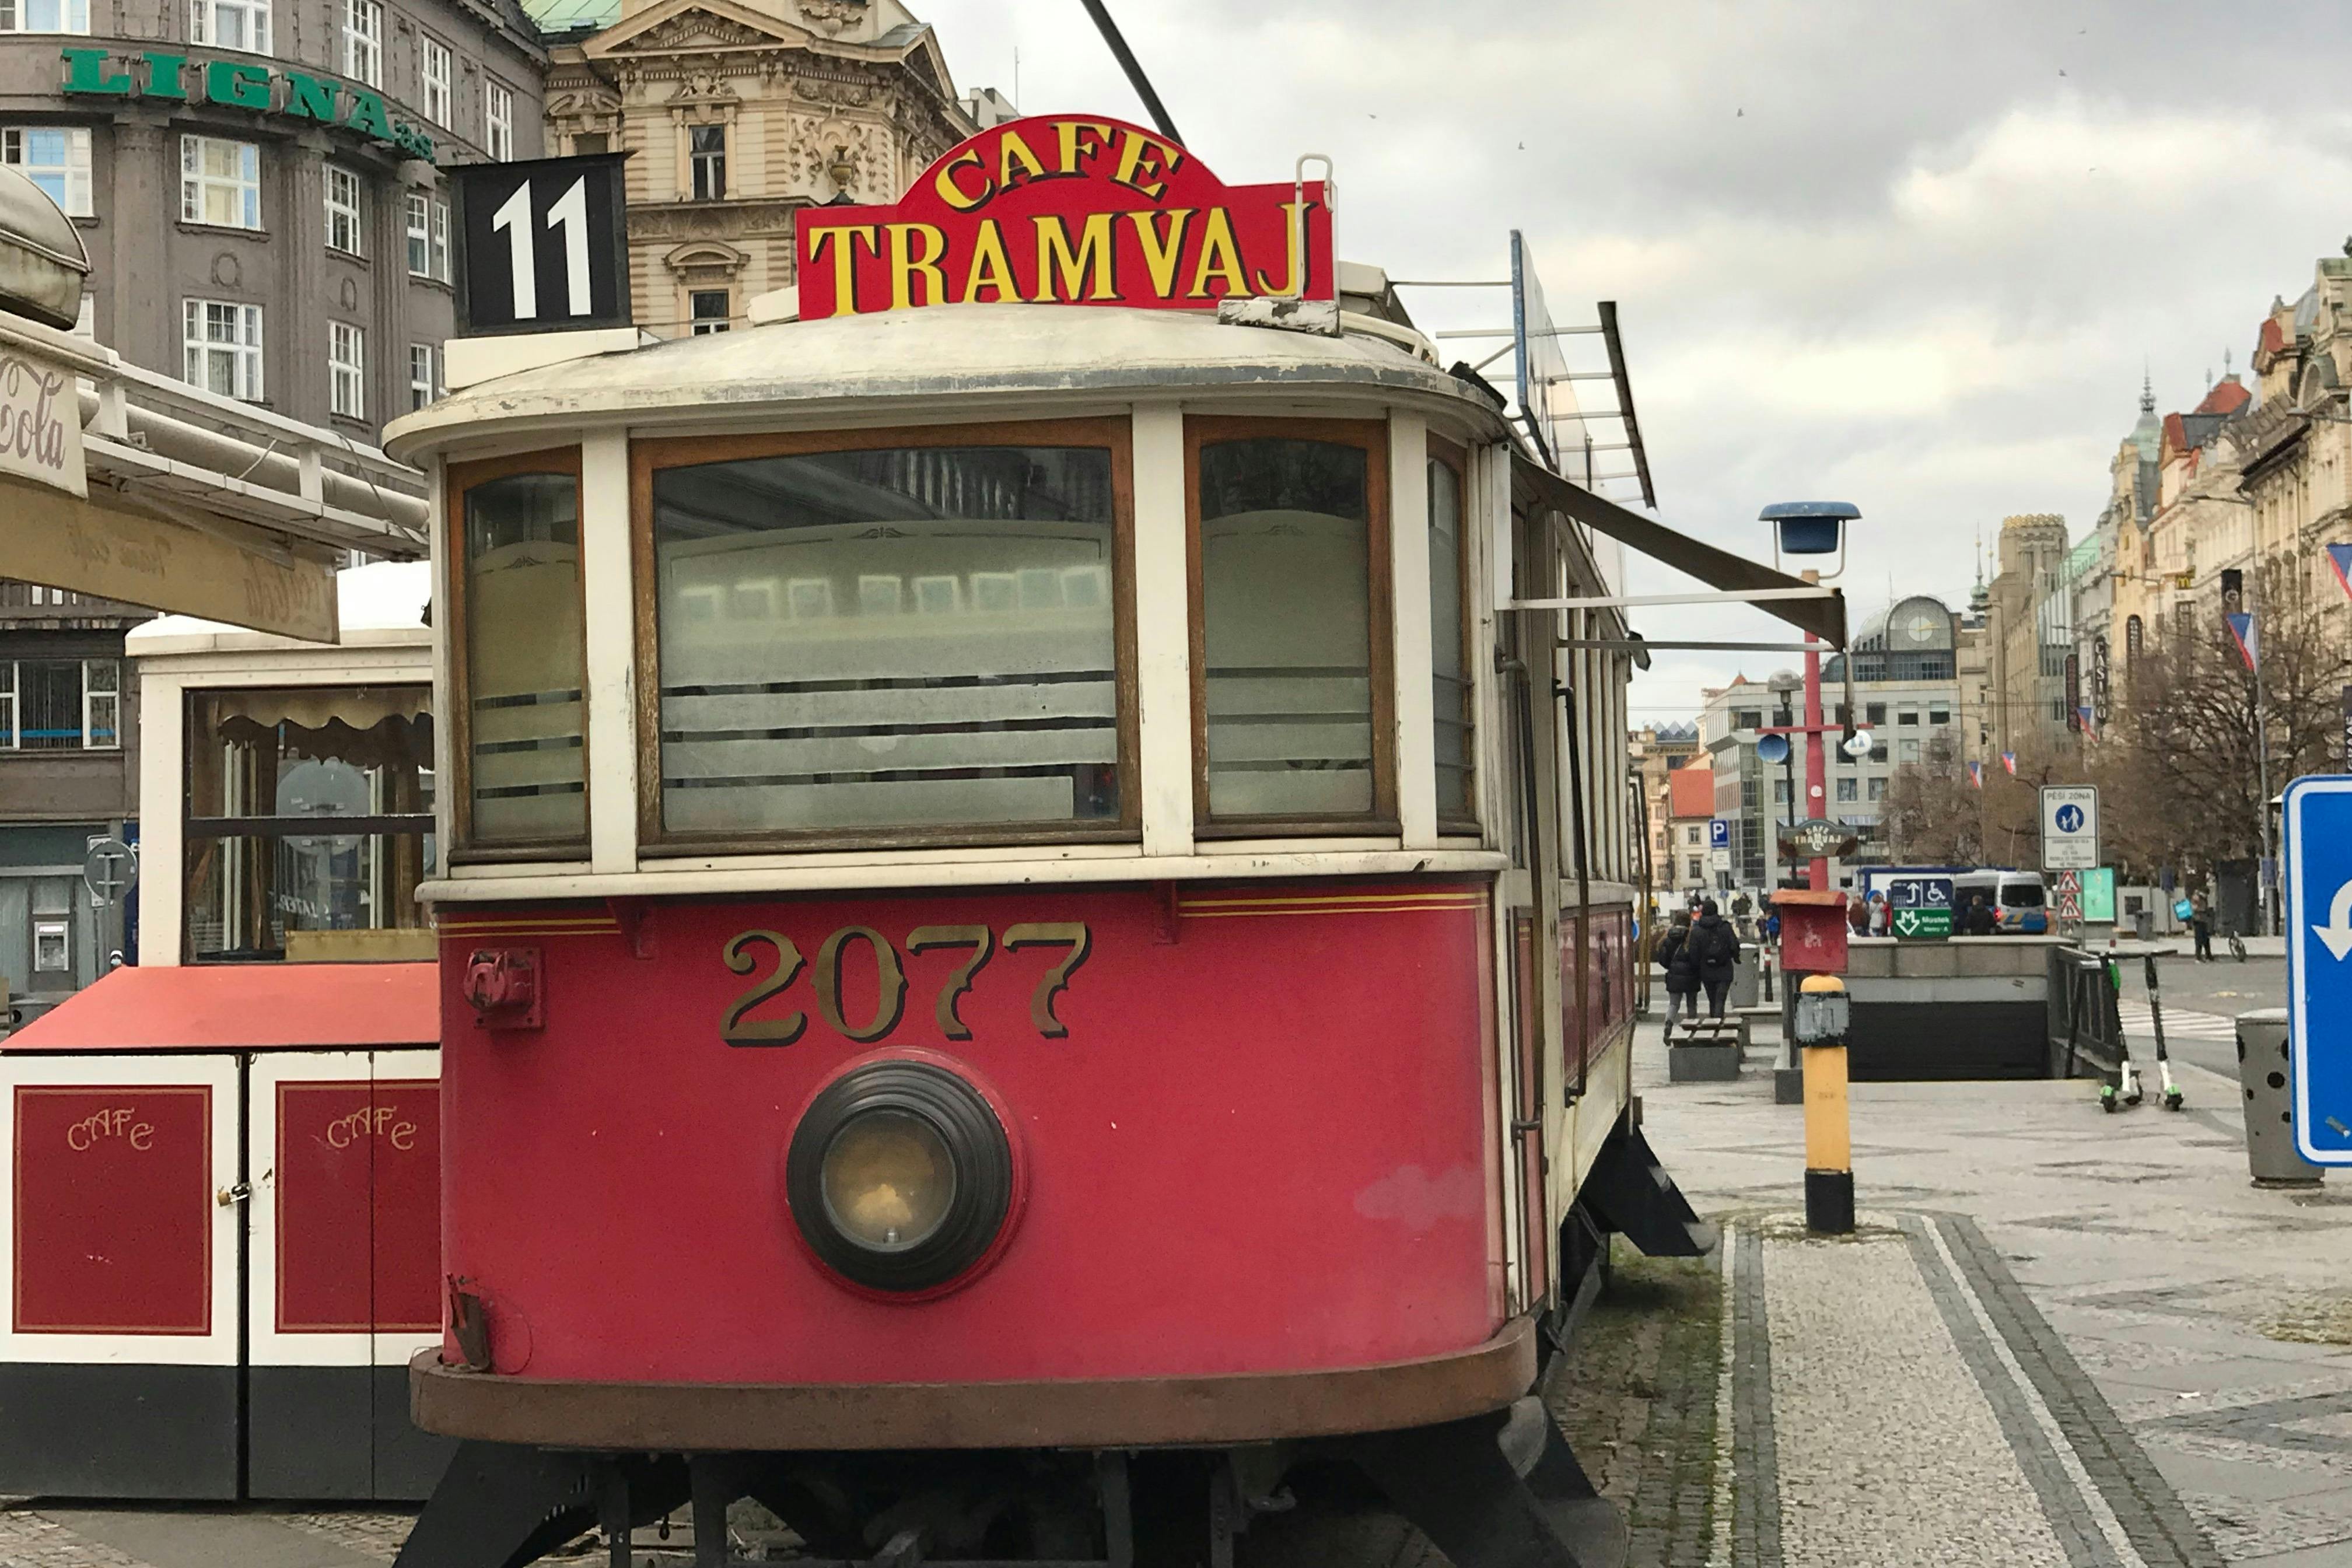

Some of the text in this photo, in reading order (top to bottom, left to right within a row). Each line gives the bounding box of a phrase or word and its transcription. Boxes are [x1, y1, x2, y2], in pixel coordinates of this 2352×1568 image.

[62, 48, 394, 141] LIGNA
[935, 121, 1183, 214] CAFE
[493, 175, 592, 319] 11
[809, 201, 1317, 318] TRAMVAJ
[719, 921, 1092, 1047] 2077
[67, 1107, 155, 1151] CAFE
[327, 1106, 417, 1150] CAFE
